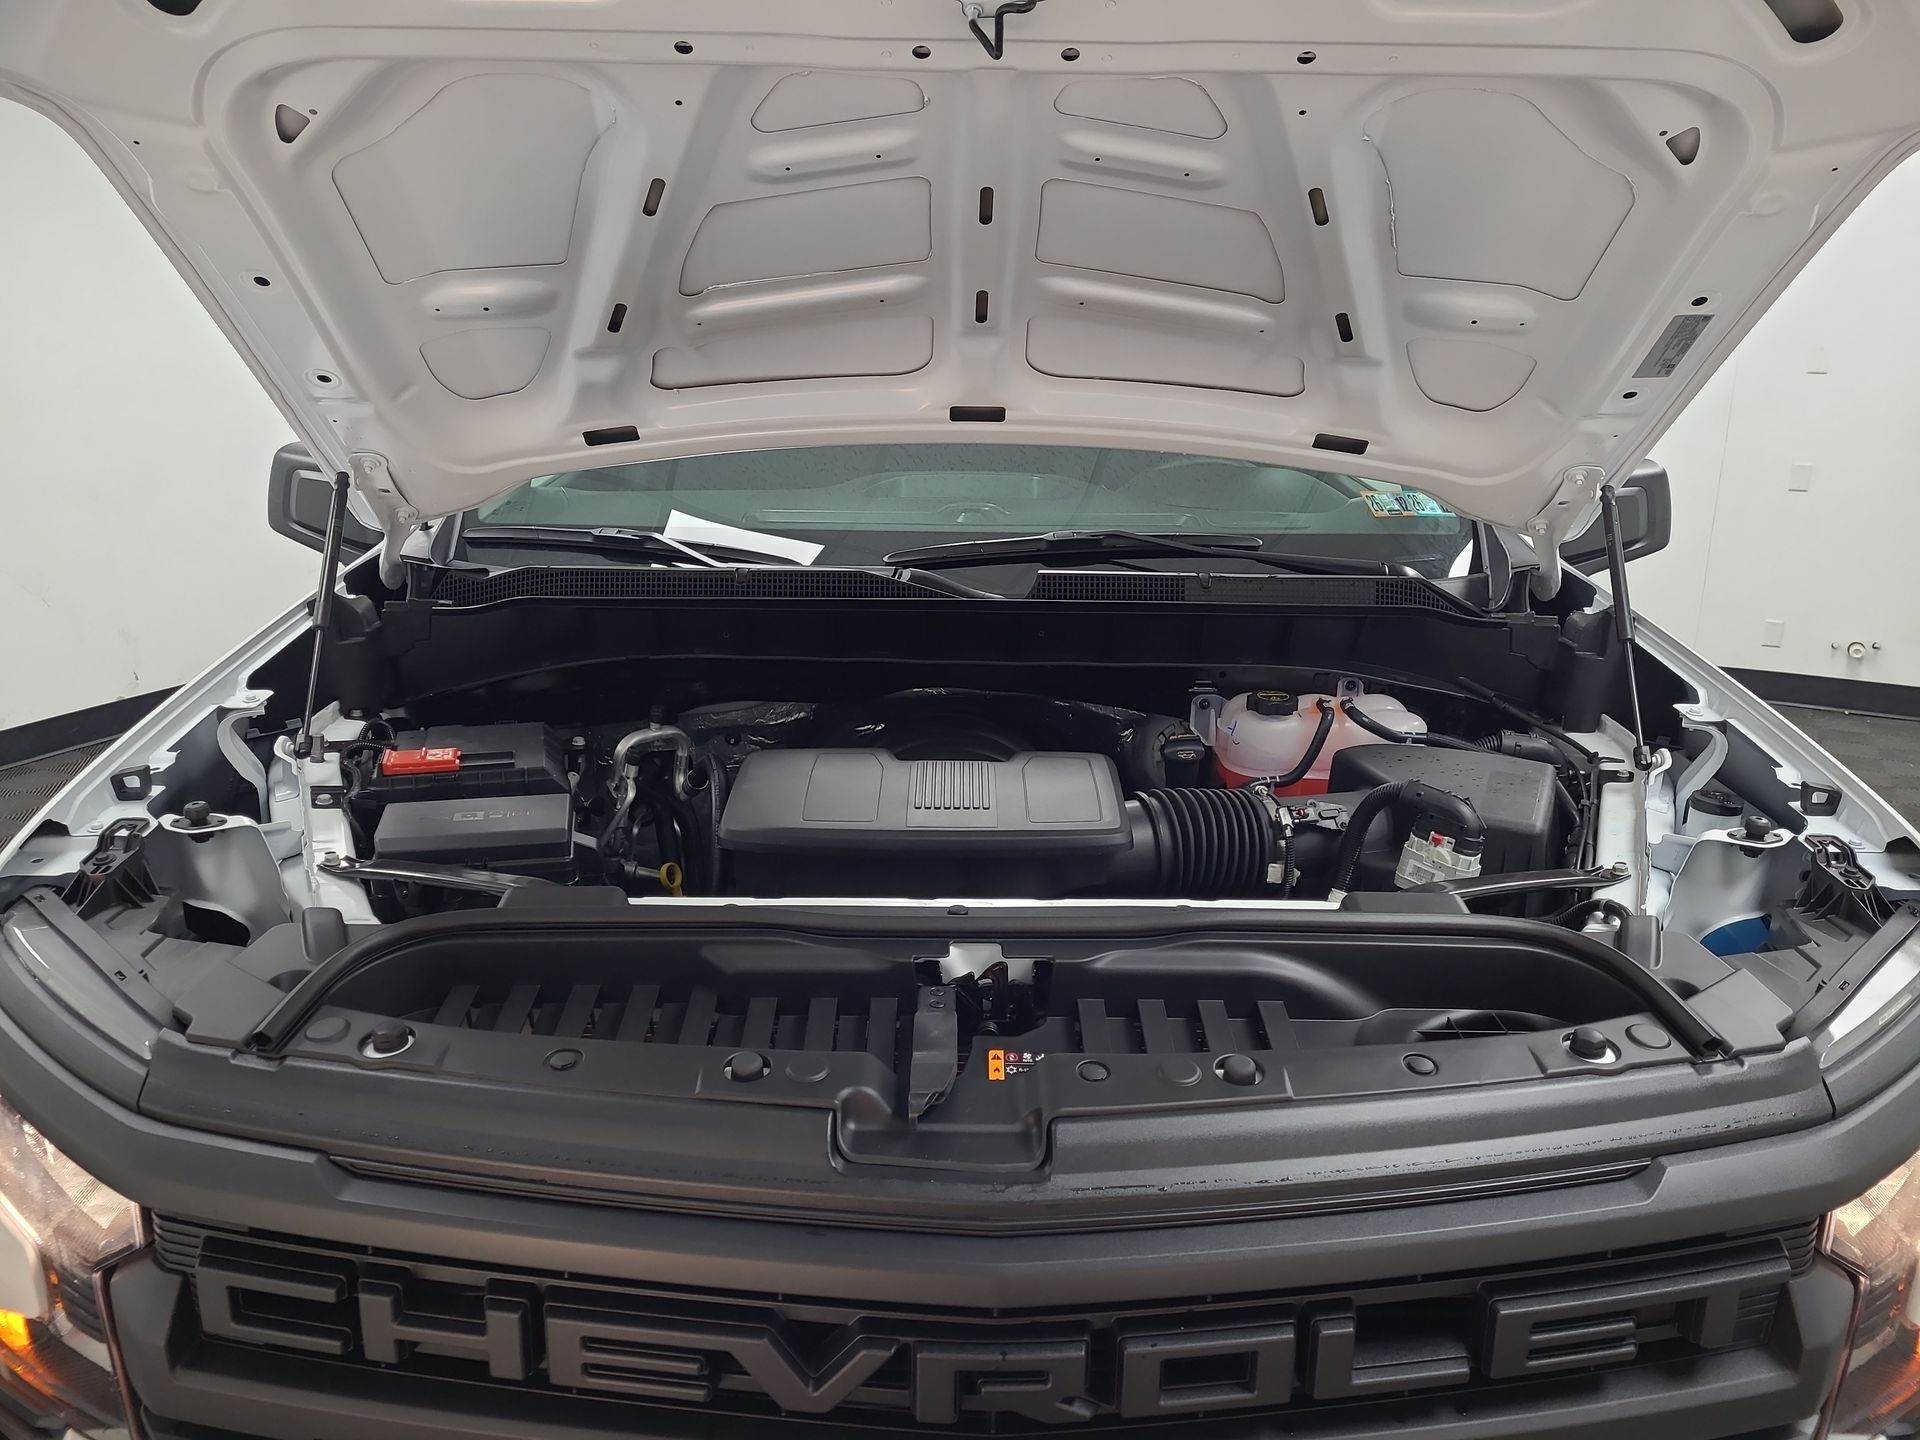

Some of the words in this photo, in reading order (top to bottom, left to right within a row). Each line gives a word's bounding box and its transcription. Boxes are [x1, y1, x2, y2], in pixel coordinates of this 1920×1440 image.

[1365, 494, 1384, 512] 26
[1395, 496, 1413, 512] 12
[1407, 494, 1426, 512] 26
[200, 1238, 1792, 1426] CHEVROLET
